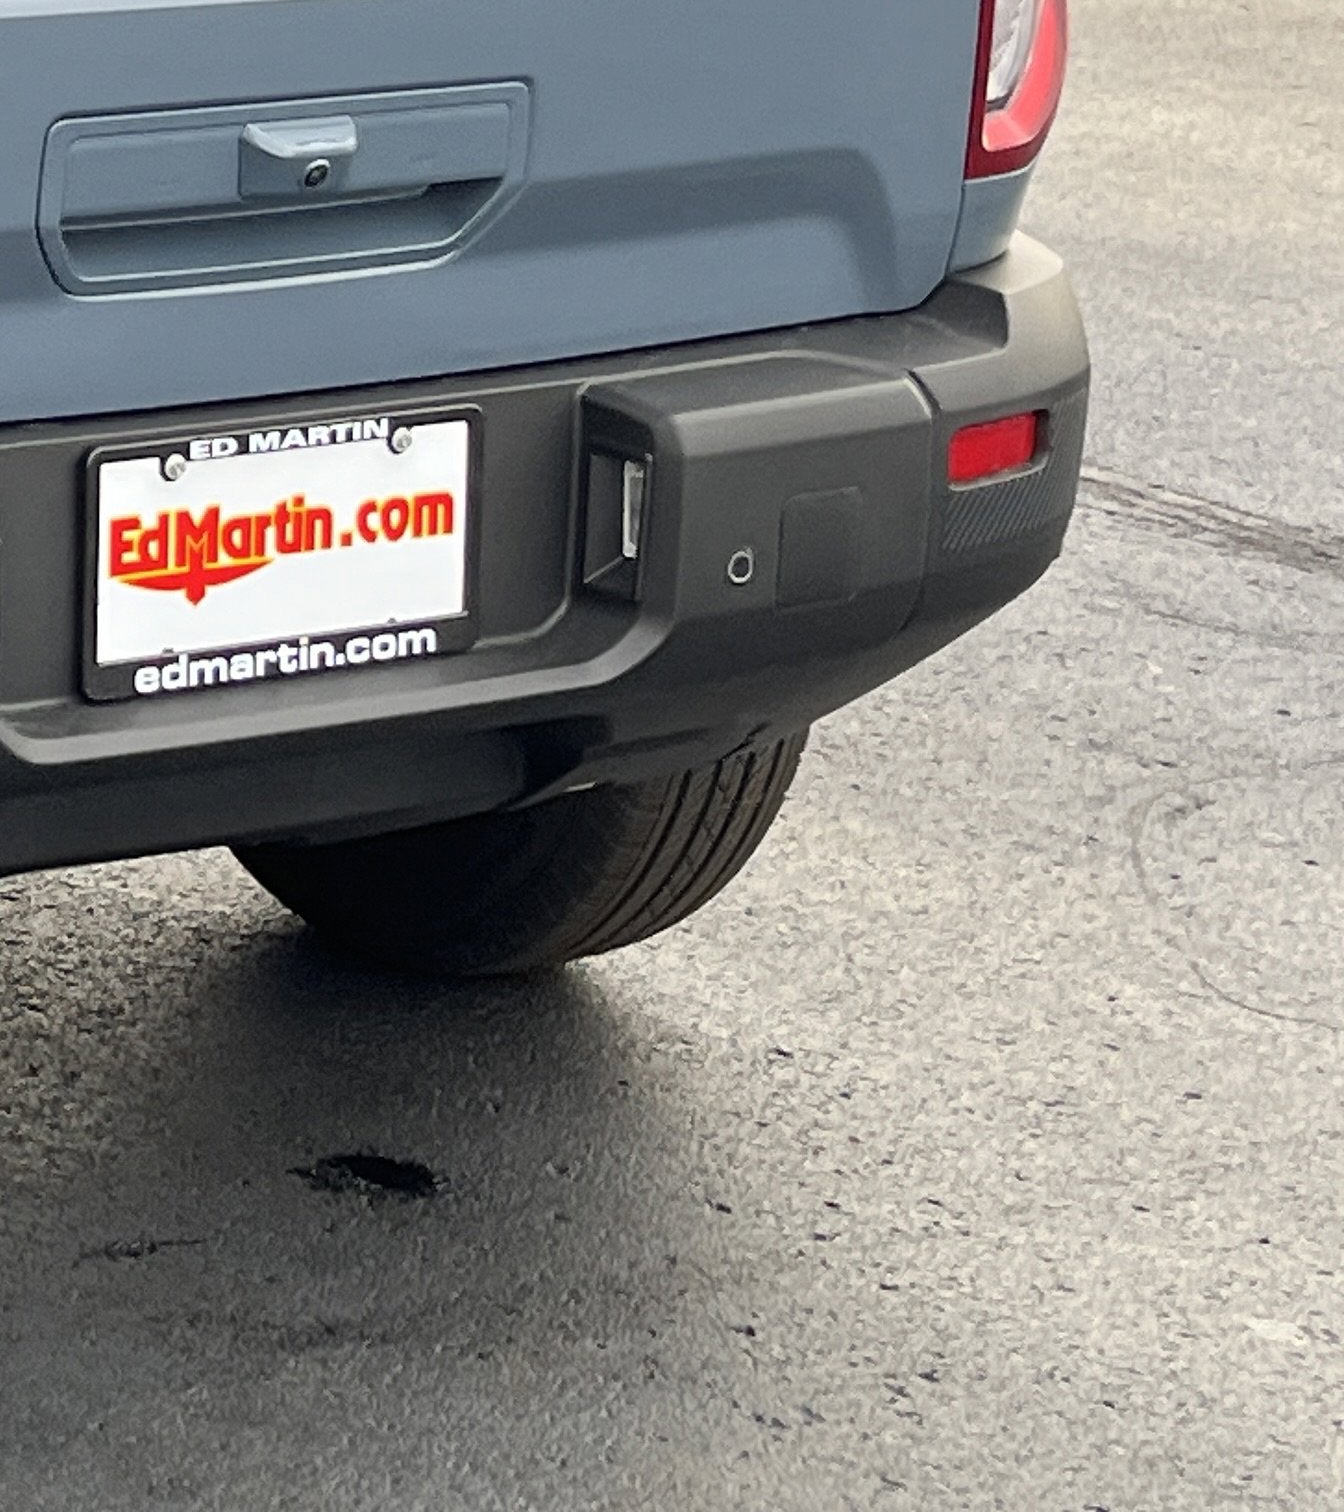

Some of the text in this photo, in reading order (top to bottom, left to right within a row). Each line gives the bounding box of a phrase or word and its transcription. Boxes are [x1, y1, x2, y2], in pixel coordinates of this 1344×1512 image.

[189, 418, 389, 462] ED MARTIN
[133, 626, 437, 695] edmartin.com
